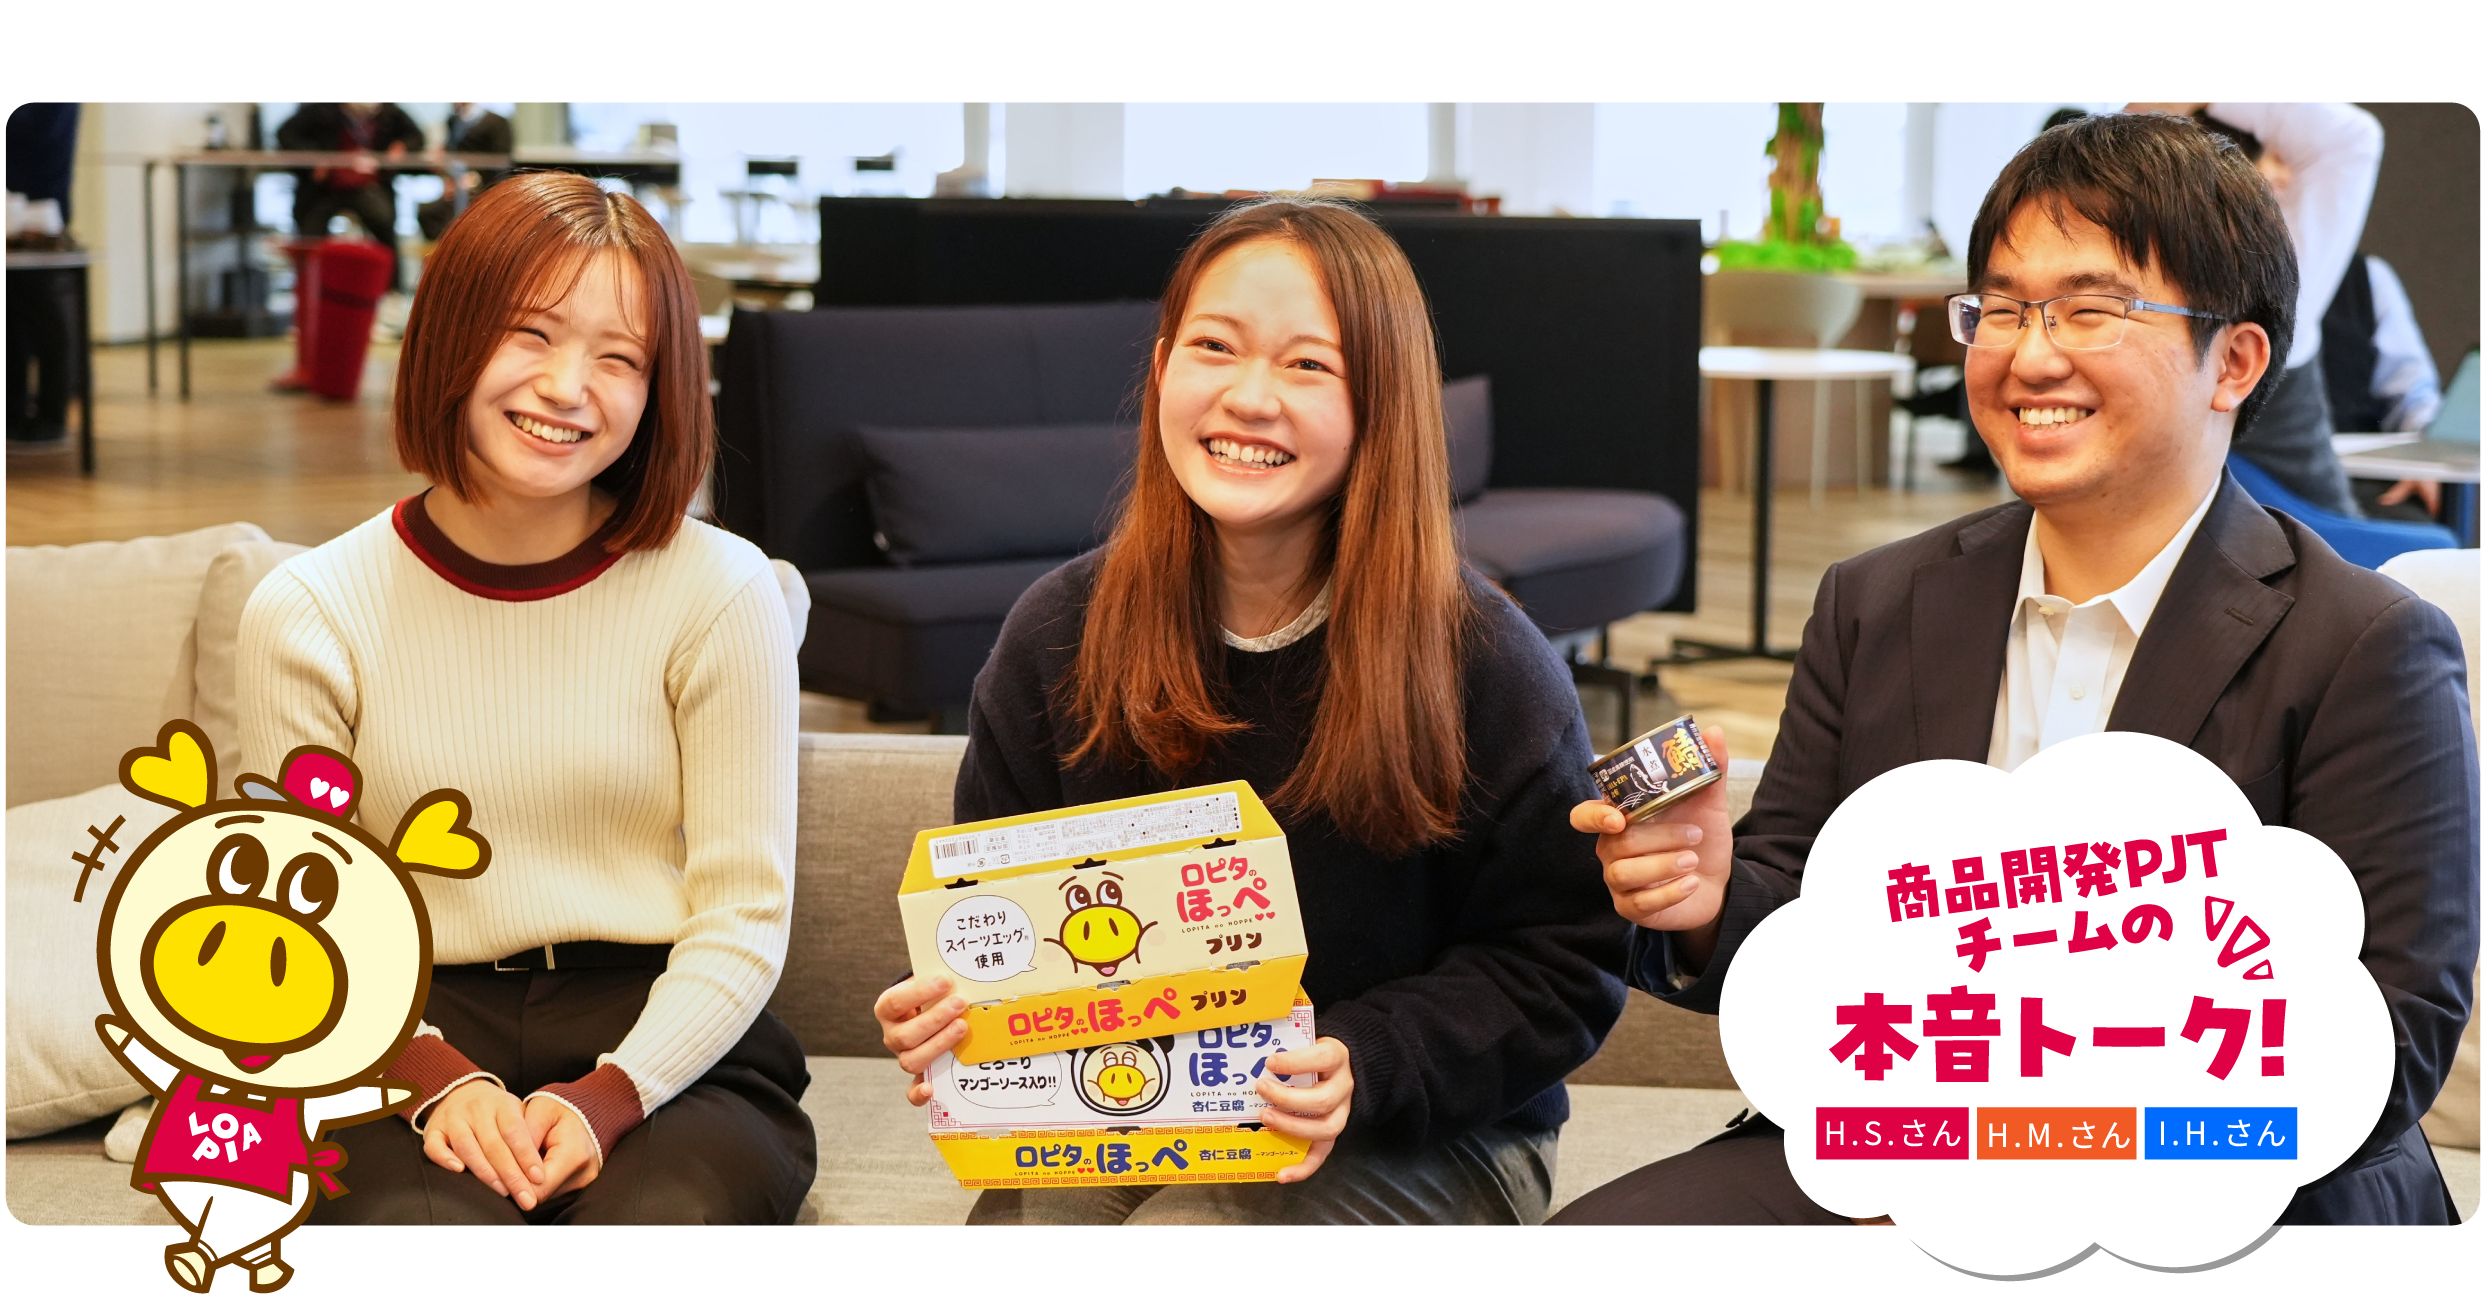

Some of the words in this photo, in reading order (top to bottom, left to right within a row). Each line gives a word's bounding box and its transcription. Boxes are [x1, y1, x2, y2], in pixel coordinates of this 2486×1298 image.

[1181, 856, 1257, 888] ロピタの
[1176, 877, 1271, 923] ほっぺ
[957, 911, 1006, 930] こだわり
[1181, 925, 1210, 933] LOPITA
[1228, 918, 1253, 926] HOPPE
[1206, 932, 1262, 955] プリン
[974, 951, 1005, 969] 使用
[1191, 989, 1247, 1011] プリン
[1010, 1038, 1034, 1046] LOPITA
[1049, 1032, 1070, 1040] HOPPE
[1198, 1022, 1281, 1049] ロピタの
[959, 1076, 1056, 1091] マンゴーソース入り!!
[1192, 1099, 1245, 1112] 杏仁豆腐
[1199, 1148, 1252, 1161] 杏仁豆腐
